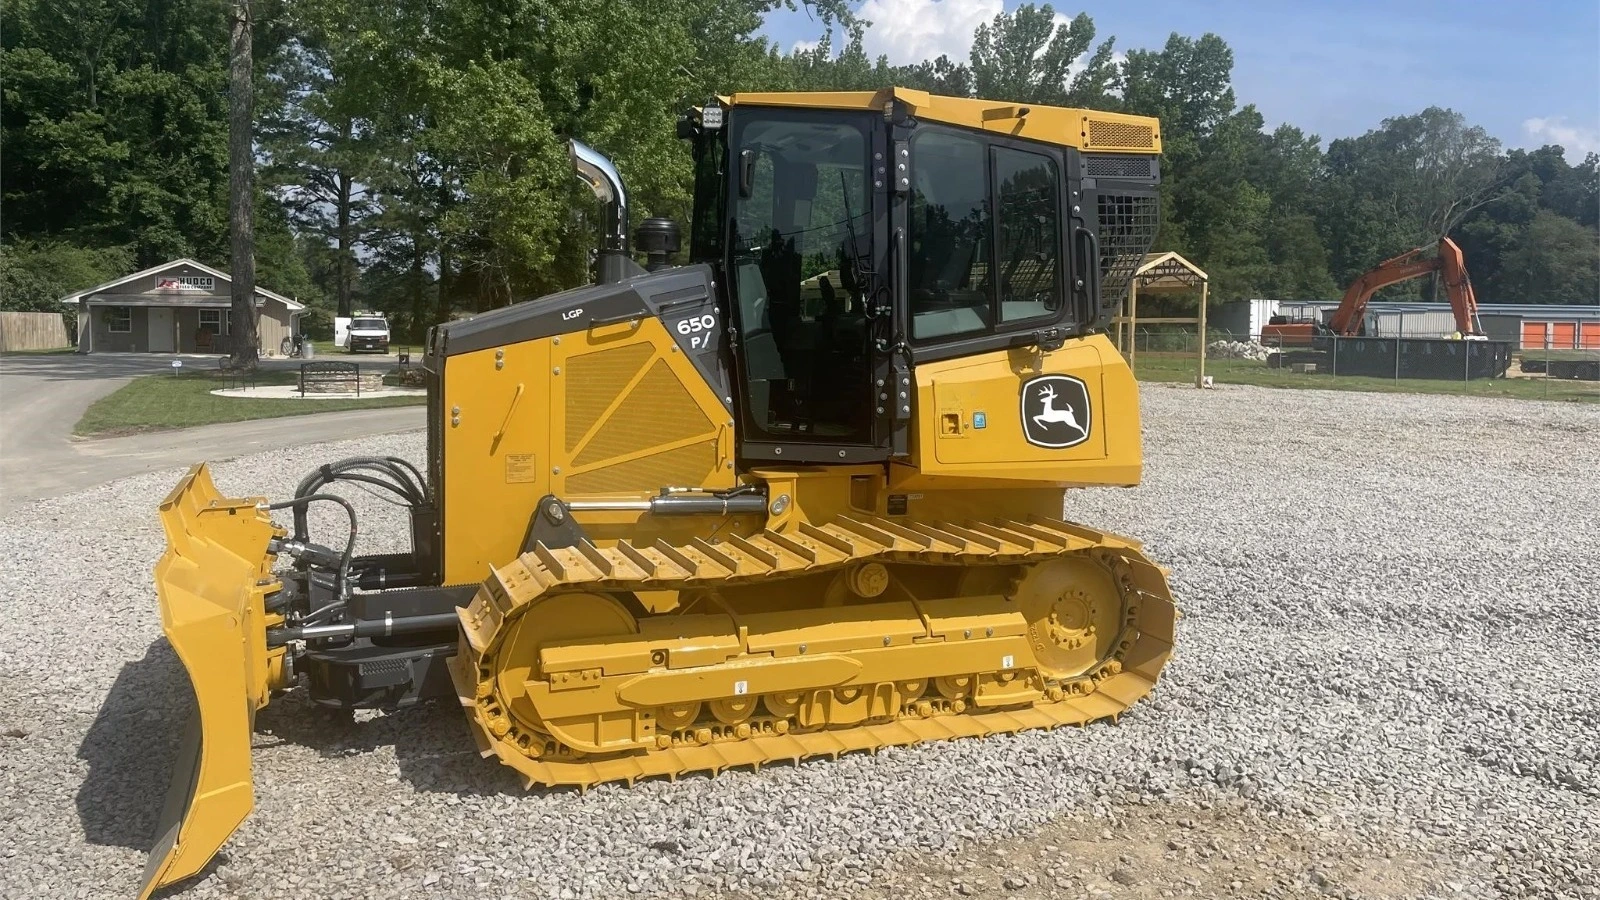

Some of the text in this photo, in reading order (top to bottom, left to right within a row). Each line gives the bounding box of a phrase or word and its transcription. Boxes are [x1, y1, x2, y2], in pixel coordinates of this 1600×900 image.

[562, 308, 583, 320] LGP
[677, 315, 715, 334] 650
[1338, 341, 1480, 355] FONTANA
